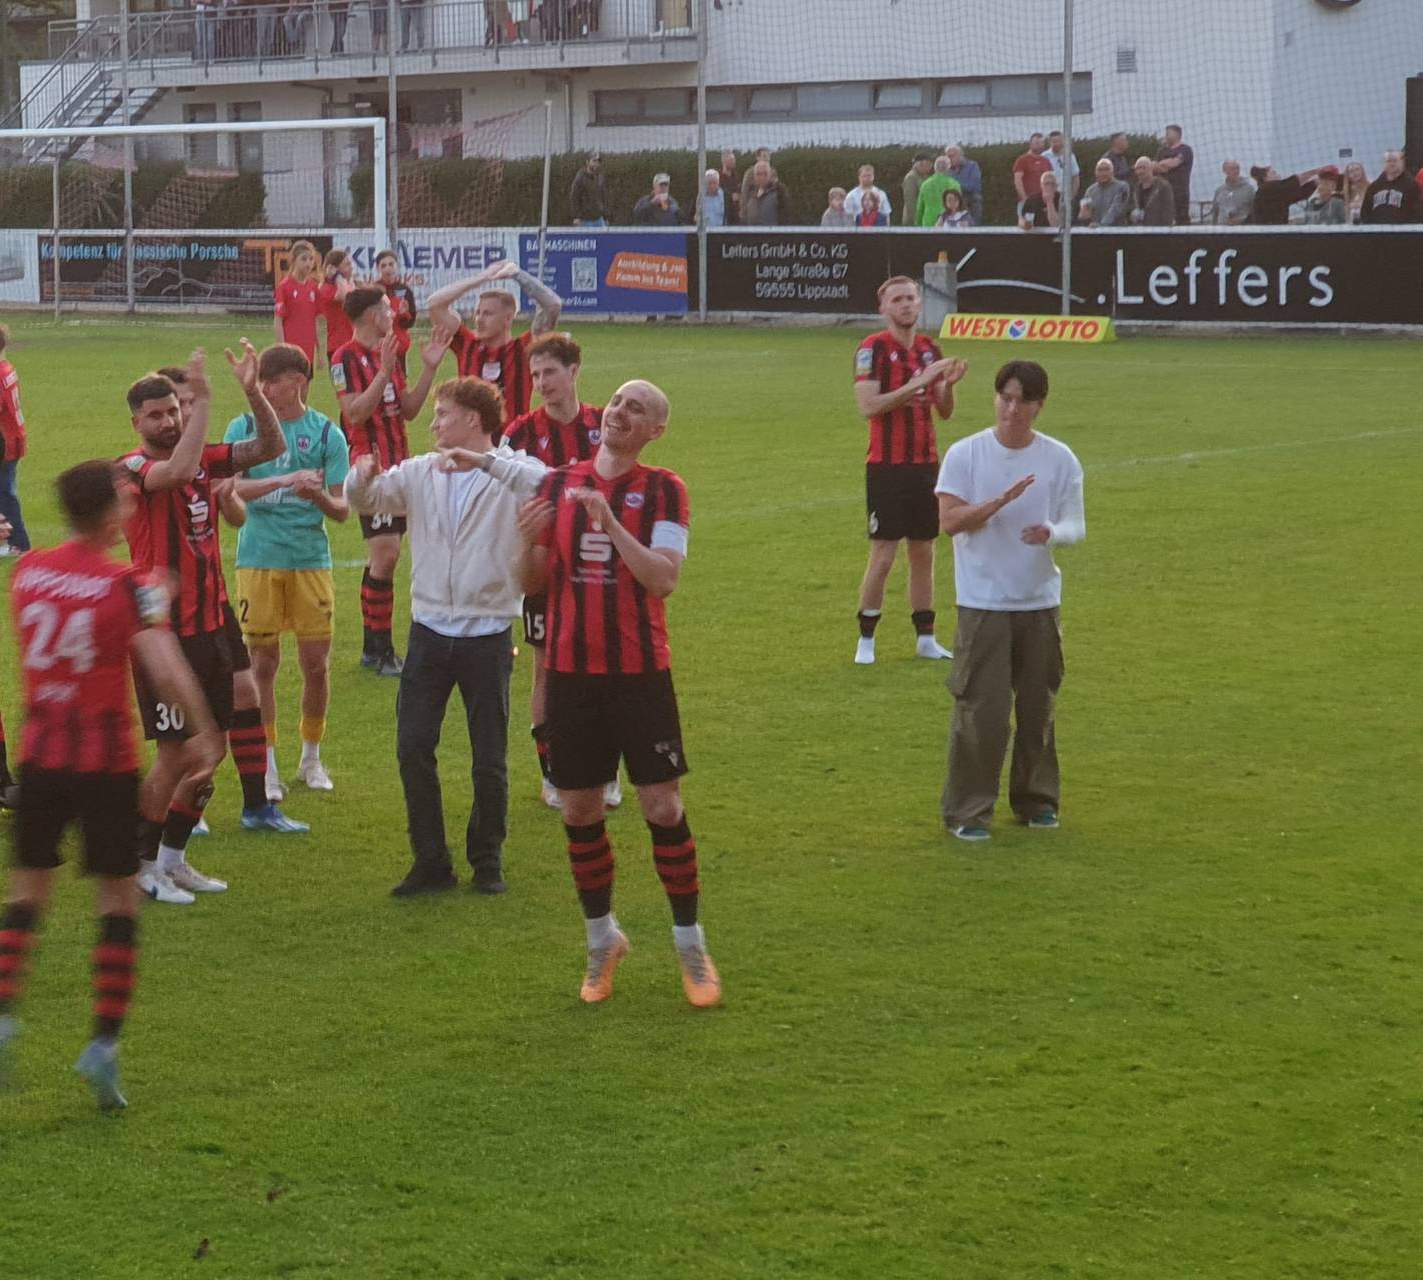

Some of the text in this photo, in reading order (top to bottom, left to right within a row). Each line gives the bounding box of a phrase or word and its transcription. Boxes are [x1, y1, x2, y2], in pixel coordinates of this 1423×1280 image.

[130, 243, 187, 261] lassische
[190, 243, 240, 262] Porsche
[526, 239, 597, 252] BAMASCHINEN
[760, 242, 796, 259] GmbH
[798, 242, 808, 258] &
[831, 242, 849, 259] KG
[797, 283, 850, 300] Lippstadt
[948, 317, 1100, 340] WEST LOTTO
[20, 600, 99, 674] 24
[526, 612, 545, 641] 15
[155, 702, 186, 733] 30
